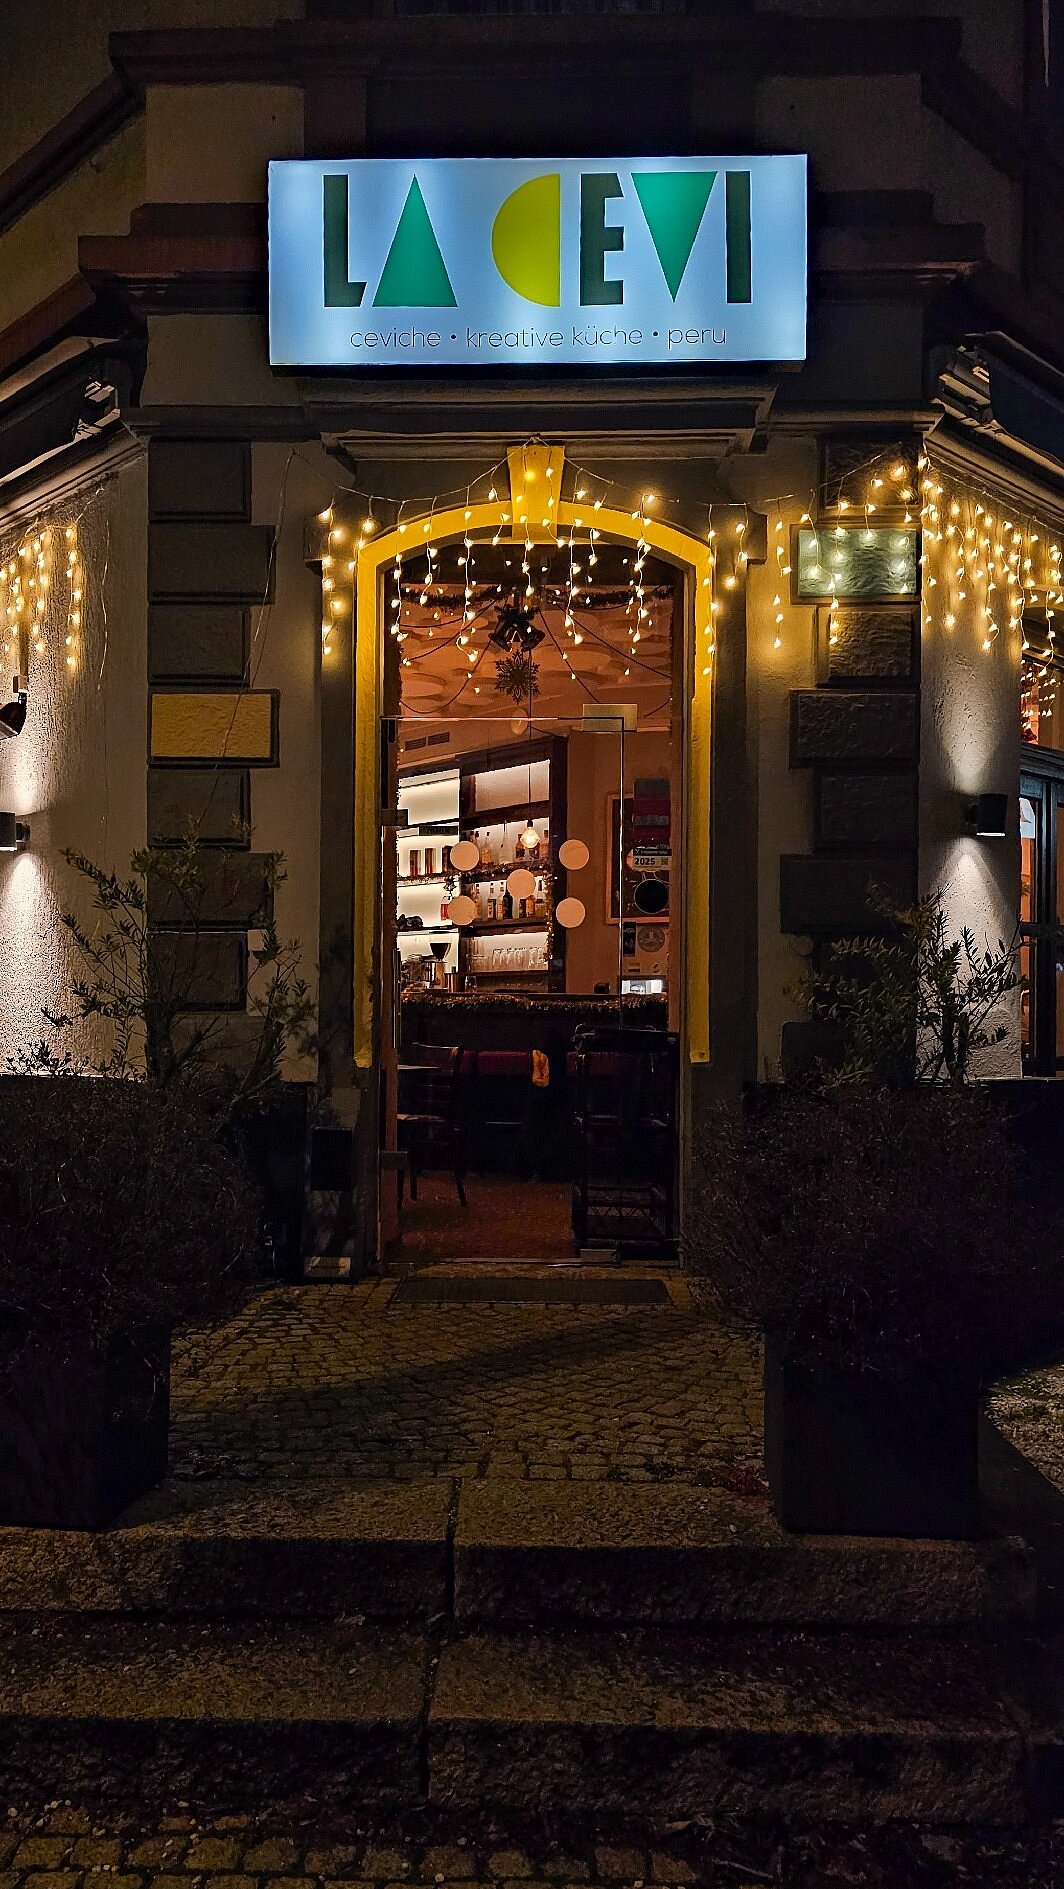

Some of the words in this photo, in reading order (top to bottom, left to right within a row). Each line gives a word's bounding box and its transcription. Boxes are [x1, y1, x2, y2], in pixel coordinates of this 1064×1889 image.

[323, 173, 458, 308] LA
[490, 170, 752, 308] CEVI
[350, 326, 441, 348] ceviche
[466, 327, 564, 348] kreative
[571, 324, 643, 346] küche
[668, 328, 726, 350] peru
[634, 857, 656, 866] 2025
